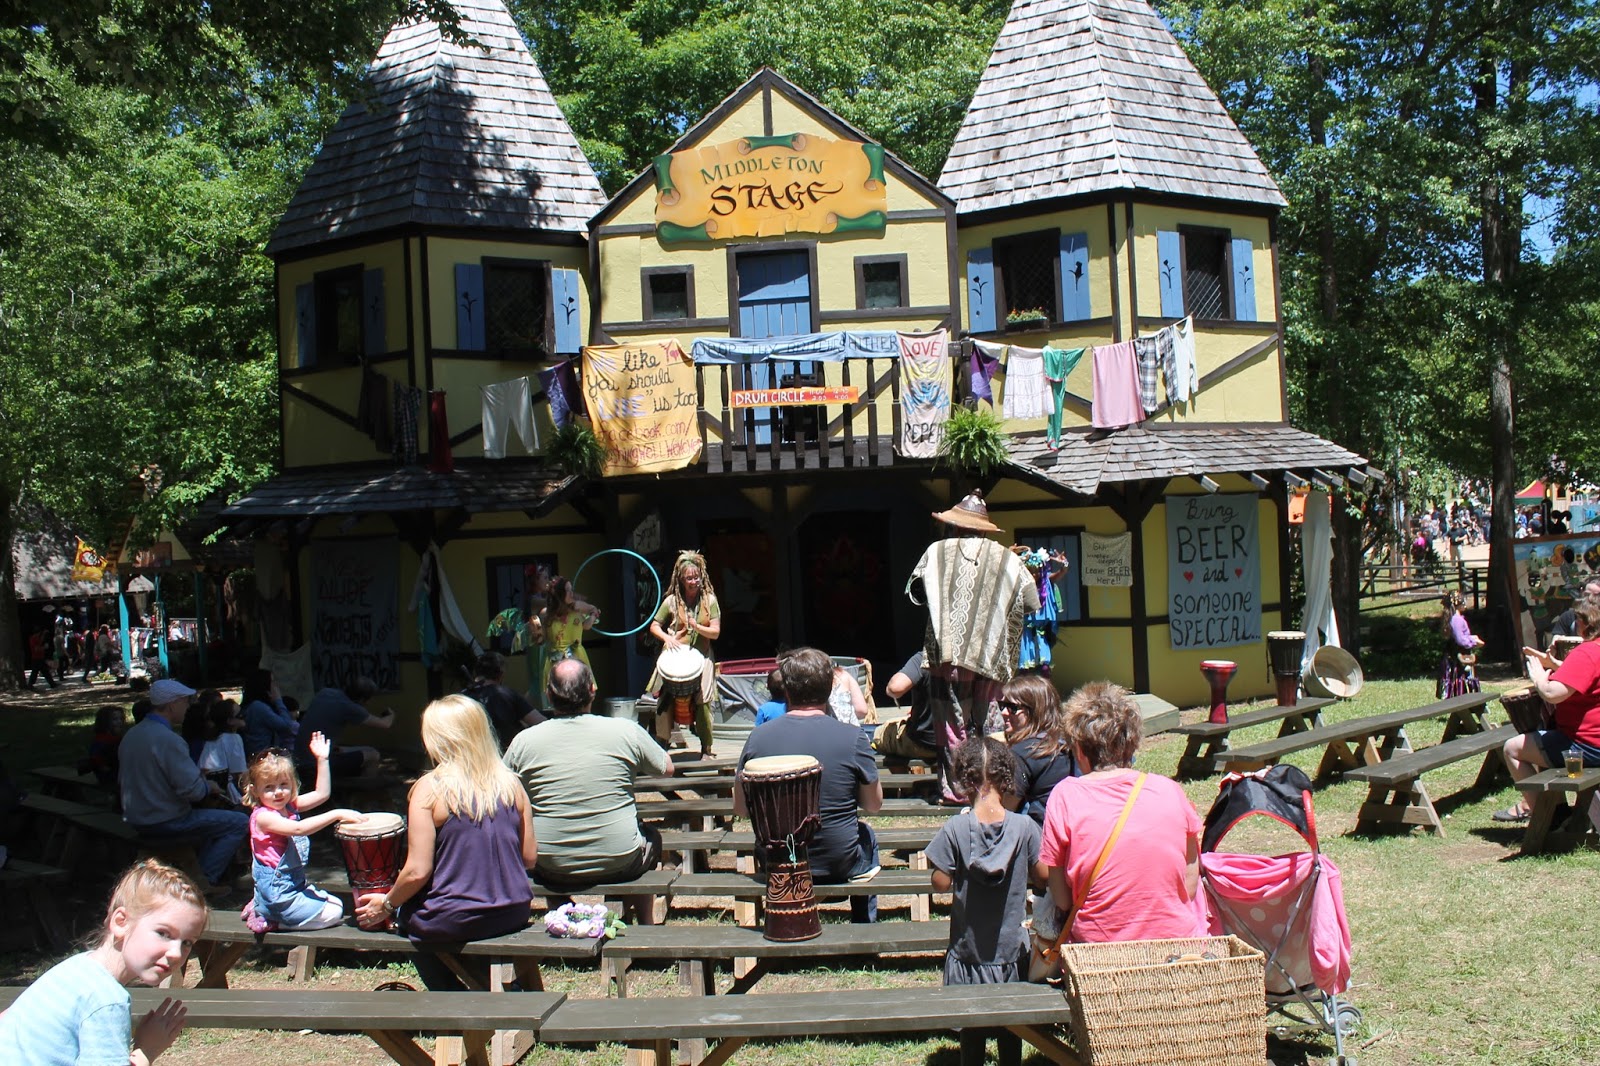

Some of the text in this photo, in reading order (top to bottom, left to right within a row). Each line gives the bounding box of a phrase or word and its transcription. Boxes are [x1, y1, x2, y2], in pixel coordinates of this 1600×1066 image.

[700, 156, 830, 185] MIDDLETON
[708, 178, 844, 216] STAGE
[901, 338, 941, 358] LOVE
[621, 349, 660, 372] like
[627, 368, 674, 390] should
[653, 397, 673, 414] us
[735, 390, 806, 406] DRUM CIRCLE
[903, 422, 944, 444] REPEA
[1185, 498, 1238, 523] Bring
[1177, 524, 1248, 564] BEER
[1107, 566, 1130, 576] BEER
[1203, 561, 1230, 583] and
